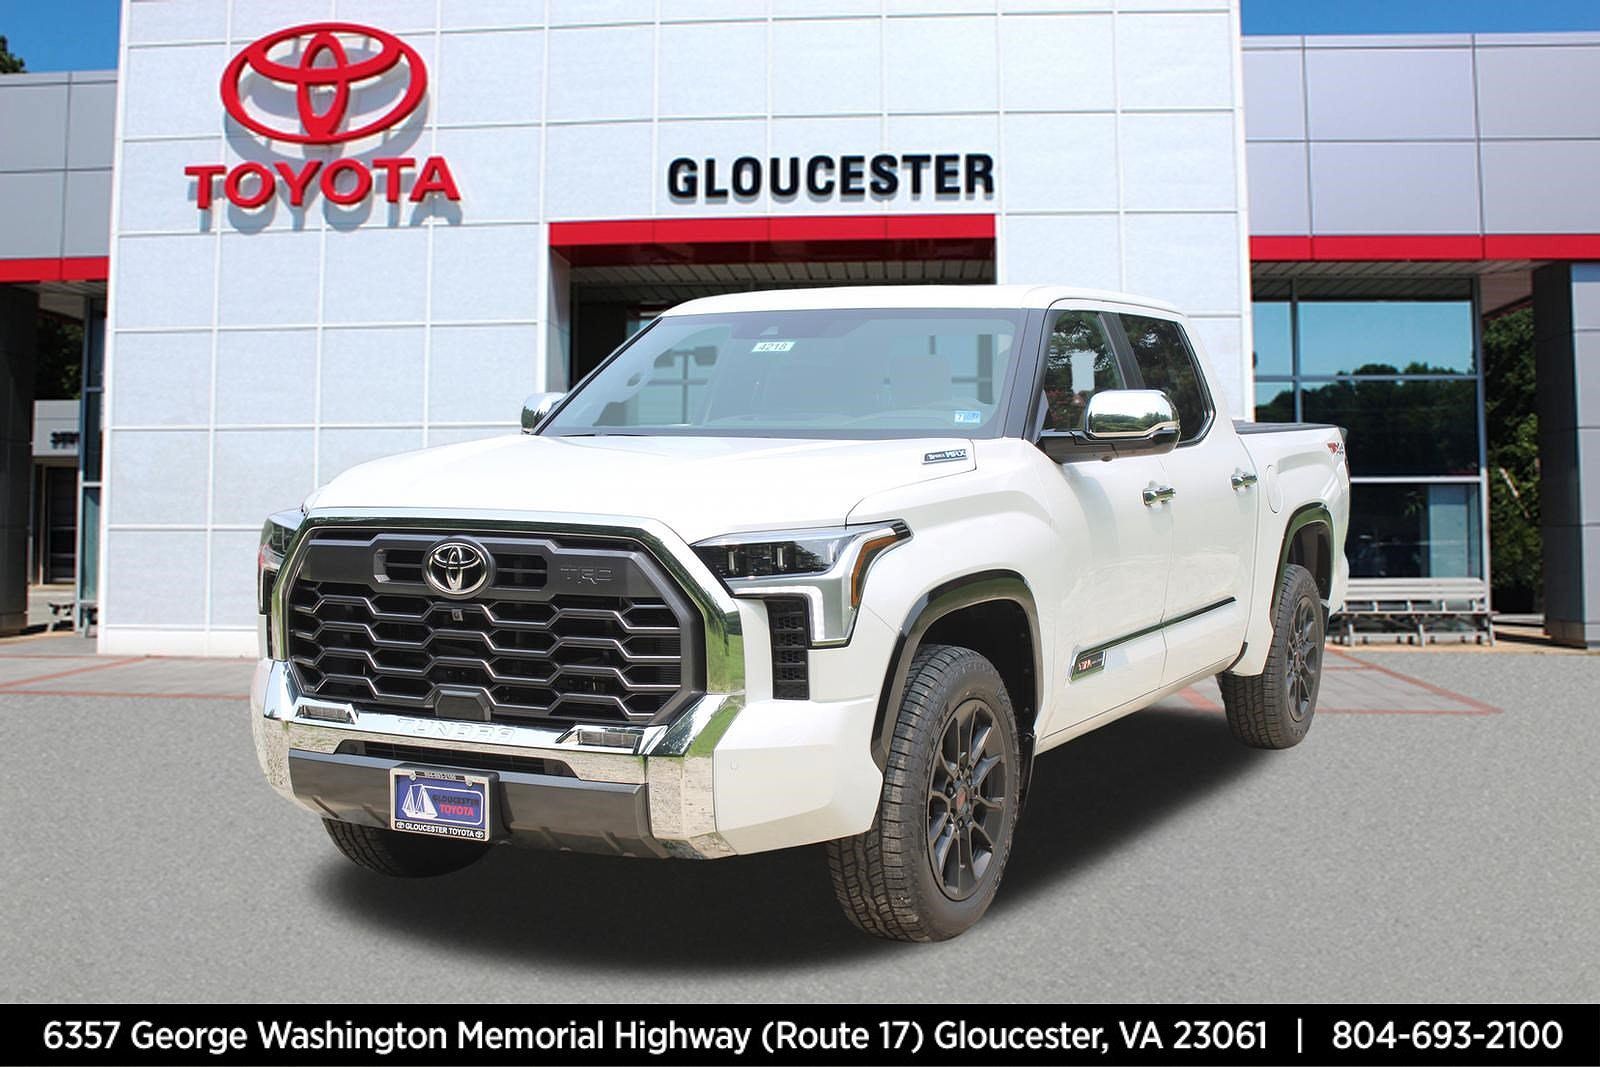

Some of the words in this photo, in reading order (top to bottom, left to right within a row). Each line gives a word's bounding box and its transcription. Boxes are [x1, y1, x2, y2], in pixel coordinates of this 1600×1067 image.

[184, 156, 461, 210] TOYOTA
[667, 154, 995, 198] GLOUCESTER
[560, 567, 614, 585] TRD
[431, 794, 480, 807] GLOUCESTER
[439, 804, 475, 817] TOYOTA
[405, 821, 448, 835] GLOUCESTER
[448, 826, 475, 838] TOYOTA
